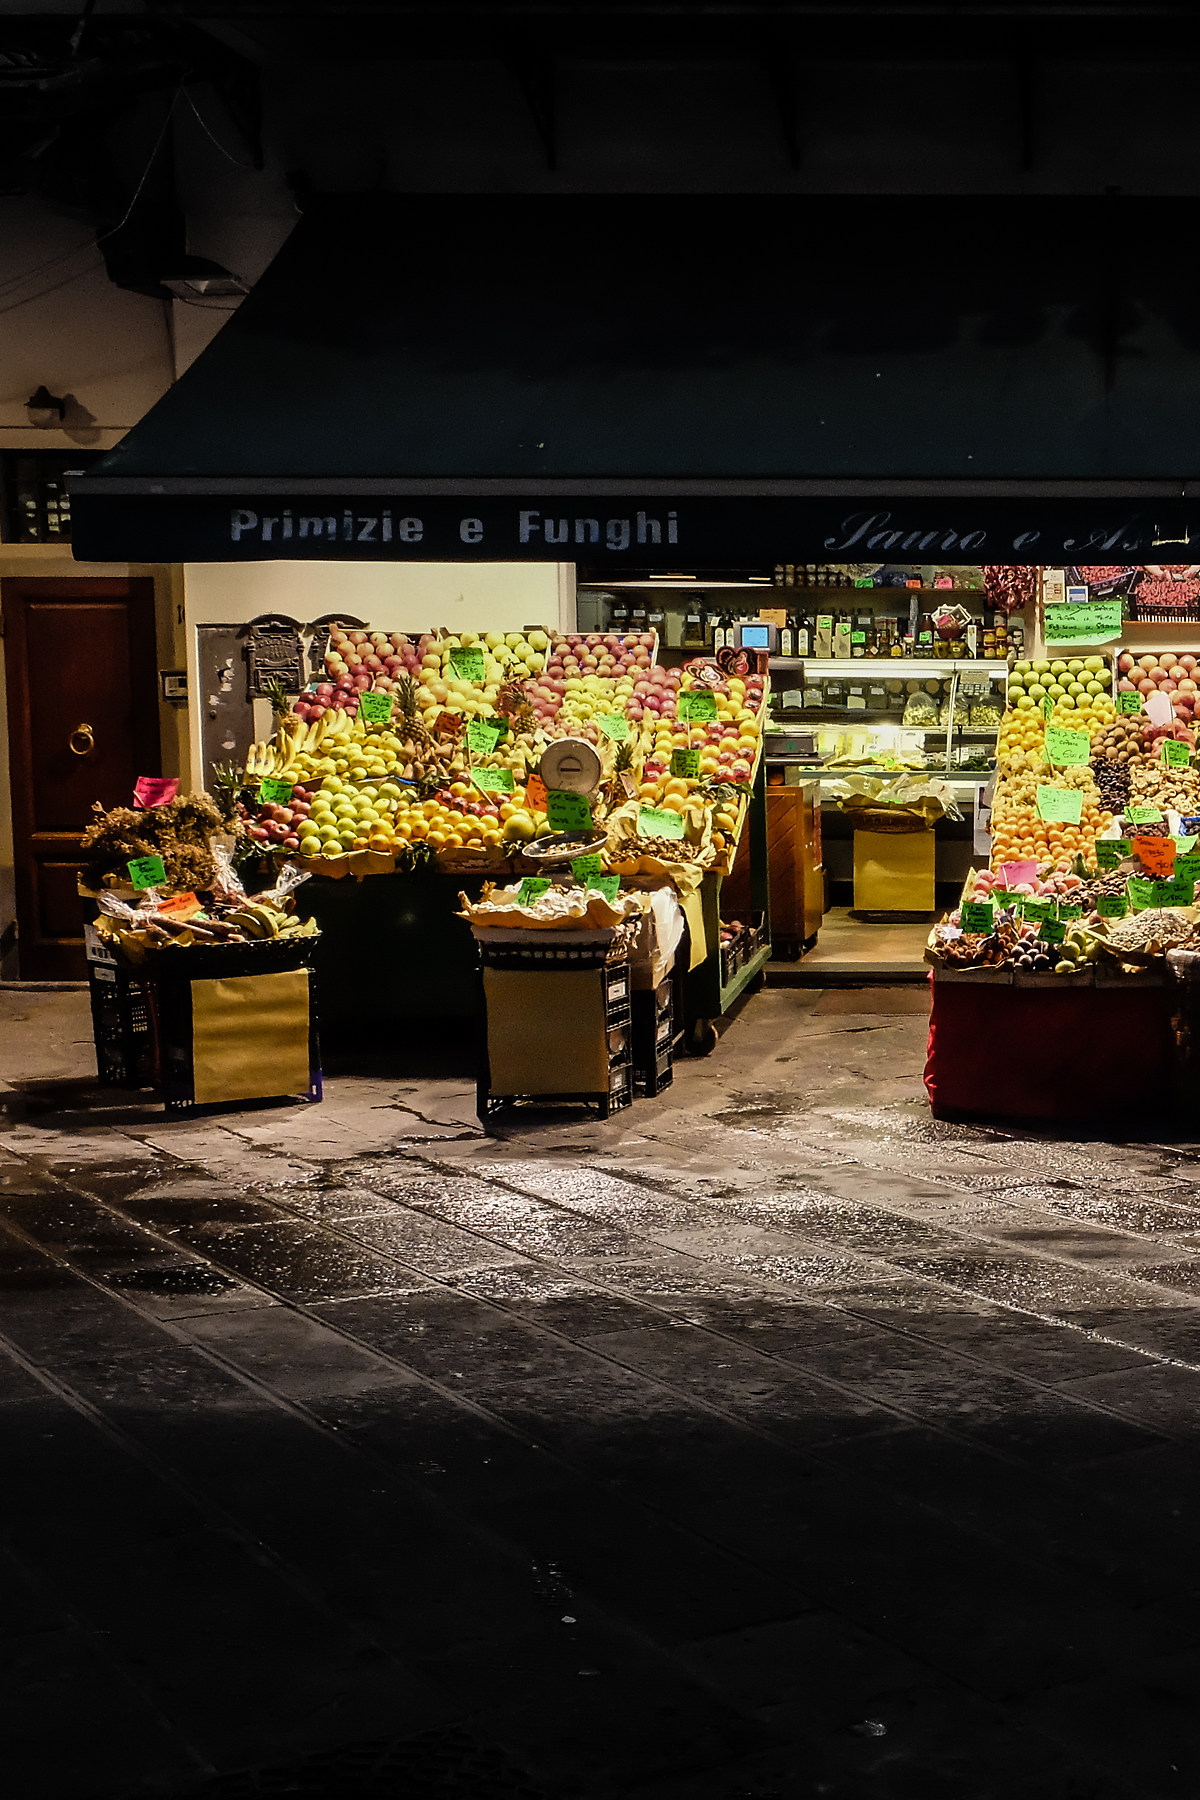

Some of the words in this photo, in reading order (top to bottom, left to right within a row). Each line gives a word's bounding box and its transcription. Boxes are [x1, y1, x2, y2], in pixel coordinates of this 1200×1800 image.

[229, 508, 424, 543] Primizie
[459, 516, 484, 544] e
[518, 509, 679, 551] Funghi
[824, 510, 988, 551] Sauro
[1012, 529, 1041, 551] e
